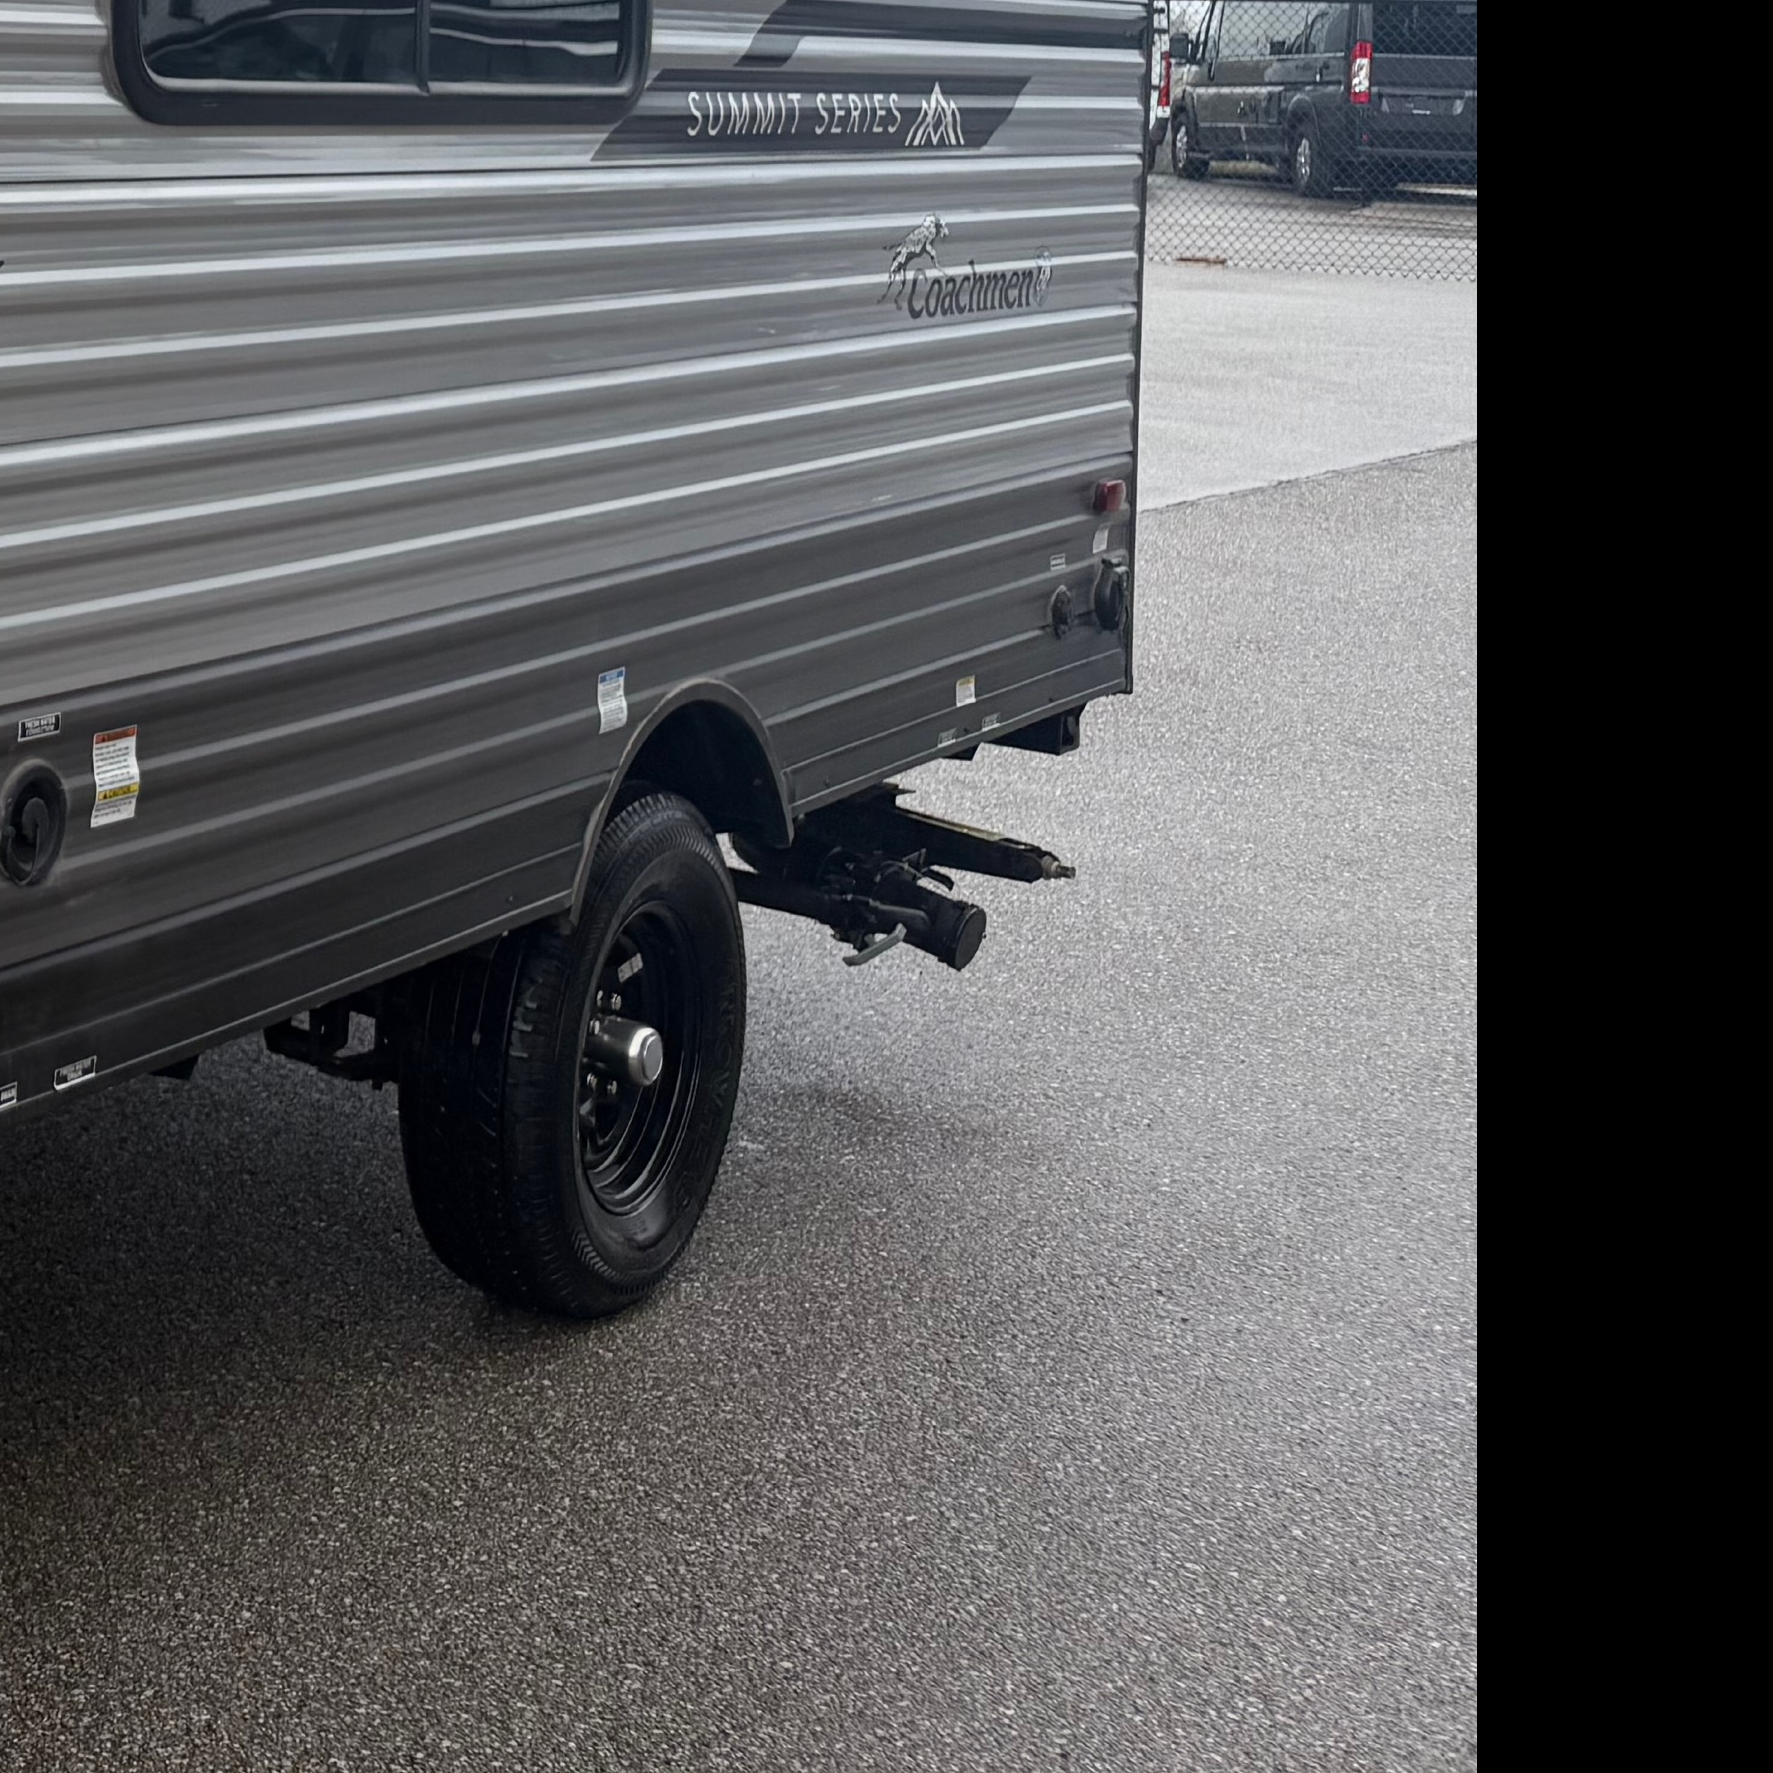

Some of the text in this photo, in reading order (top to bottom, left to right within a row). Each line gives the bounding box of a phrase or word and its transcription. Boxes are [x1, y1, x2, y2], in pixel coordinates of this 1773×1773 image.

[686, 91, 902, 137] SUMMIT SERIES
[907, 258, 1035, 319] Coachmen
